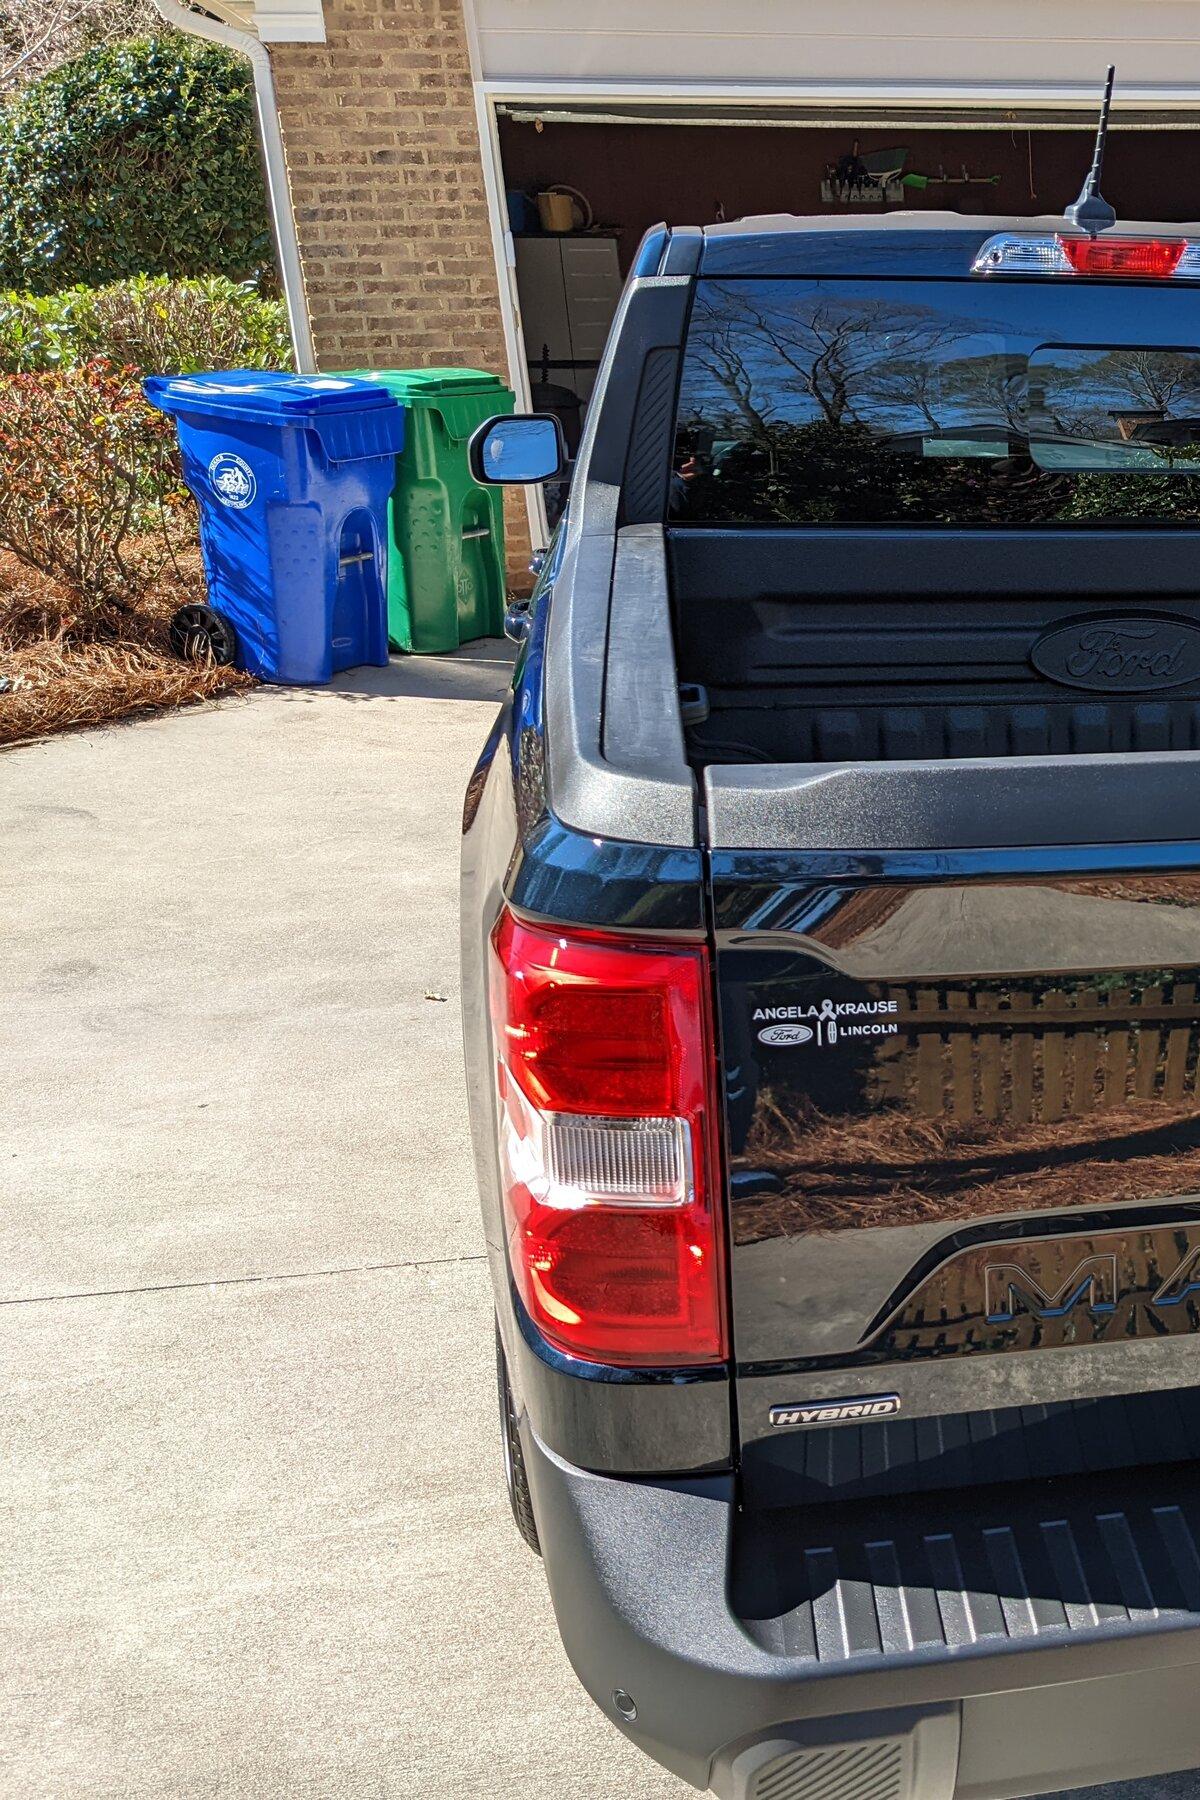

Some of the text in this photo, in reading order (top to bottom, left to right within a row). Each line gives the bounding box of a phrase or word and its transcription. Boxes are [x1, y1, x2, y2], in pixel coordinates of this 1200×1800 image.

[1065, 626, 1187, 678] Ford
[752, 1000, 898, 1021] ANGELA KRAUSE
[769, 1028, 801, 1041] Ford
[840, 1024, 898, 1036] LINCOLN
[776, 1401, 894, 1425] HYBRID
